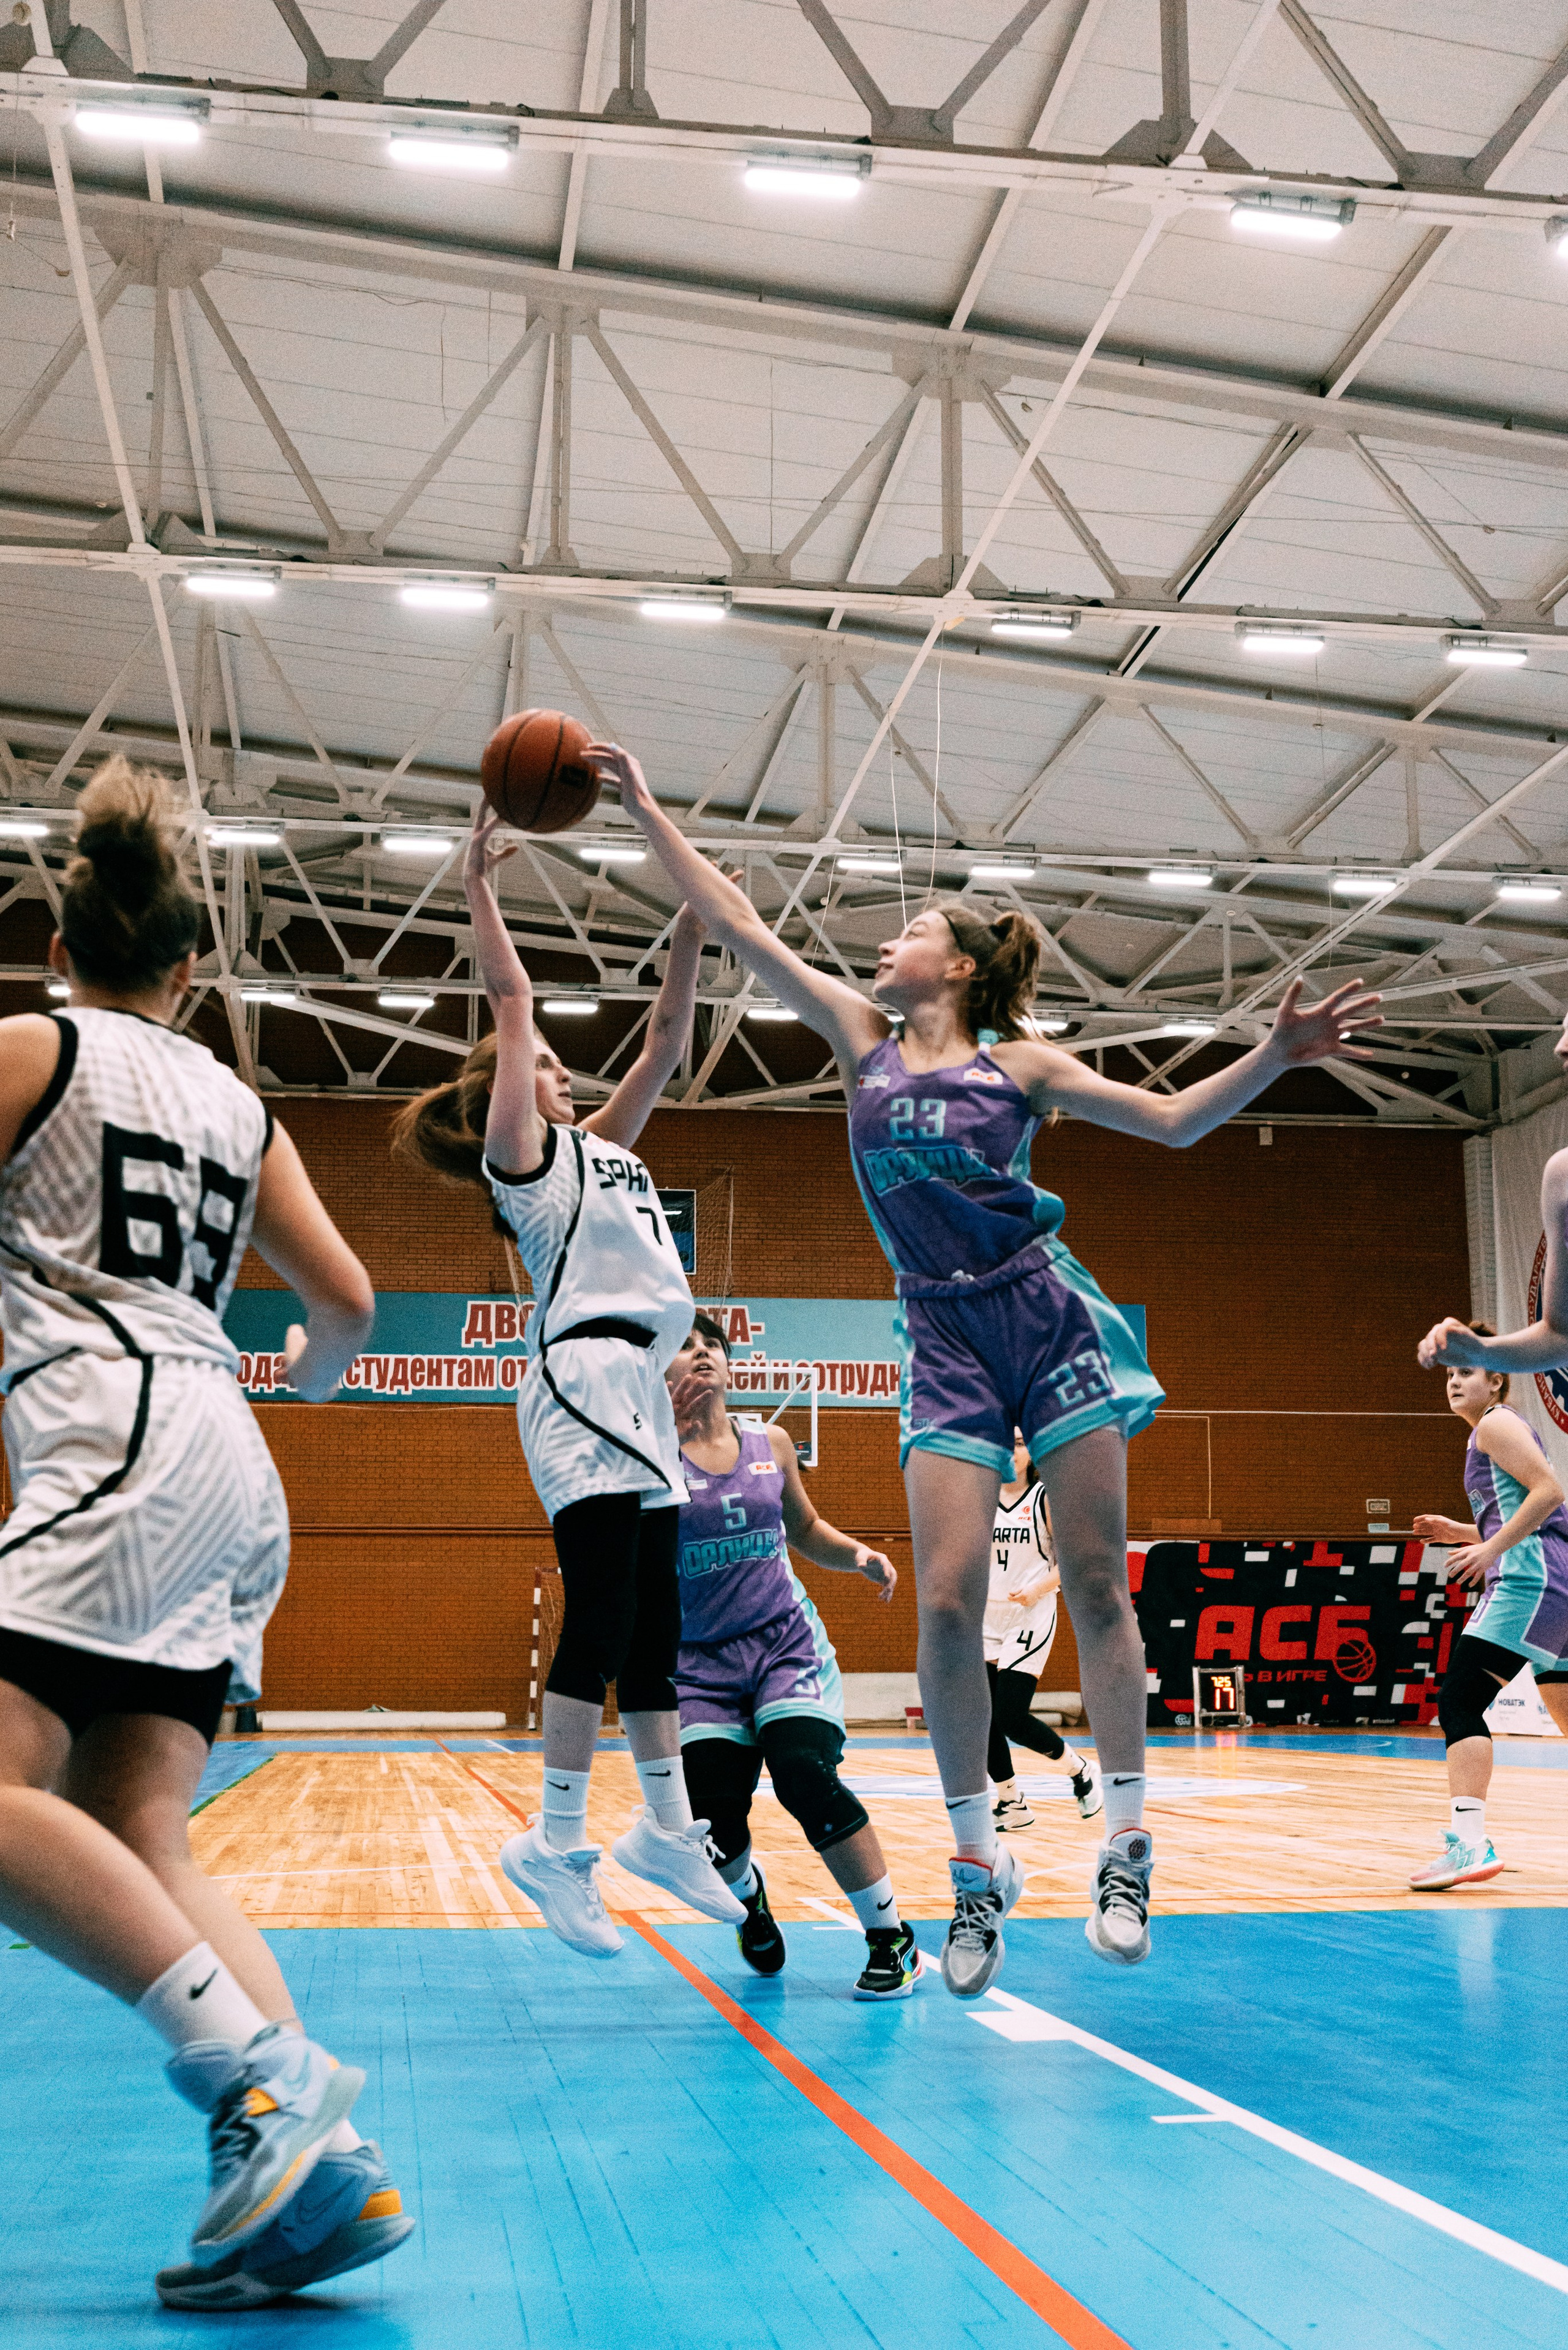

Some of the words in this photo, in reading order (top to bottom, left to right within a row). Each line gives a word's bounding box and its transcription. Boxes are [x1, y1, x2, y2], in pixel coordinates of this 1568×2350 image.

[890, 1098, 946, 1140] 23
[99, 1121, 248, 1312] 69
[636, 1206, 663, 1246] 7
[345, 1356, 494, 1392] студентам
[1047, 1350, 1111, 1408] 23
[720, 1493, 747, 1530] 5
[997, 1550, 1009, 1572] 4
[1016, 1630, 1034, 1651] 4
[1194, 1605, 1374, 1661] АСБ
[1257, 1670, 1273, 1683] В
[1276, 1670, 1328, 1682] ИГРЕ
[1215, 1687, 1235, 1710] 17
[1498, 1698, 1526, 1707] НОВАТЭК
